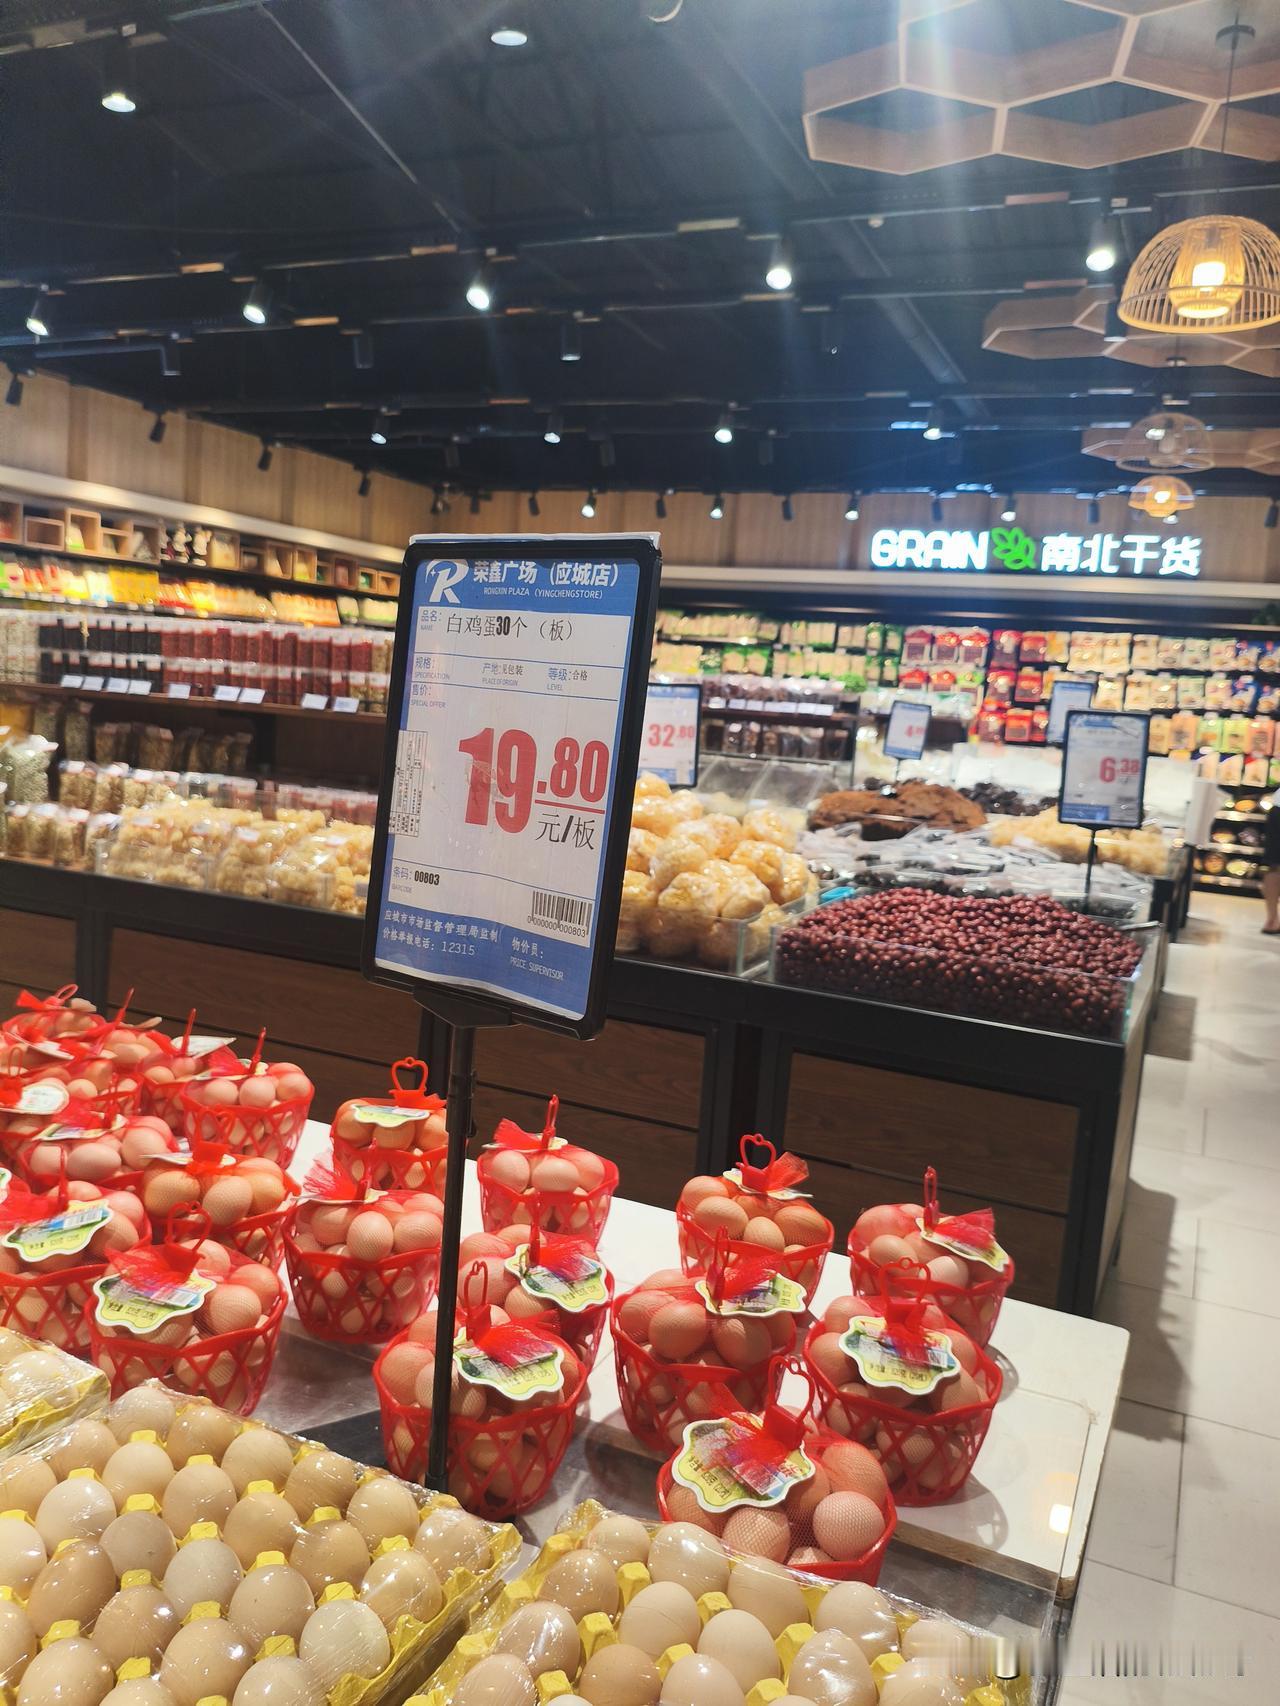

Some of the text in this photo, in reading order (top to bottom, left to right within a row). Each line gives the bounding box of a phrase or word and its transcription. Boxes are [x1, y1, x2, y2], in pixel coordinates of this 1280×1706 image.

[870, 529, 990, 570] GRAIN
[1040, 532, 1203, 577] 南北干货
[508, 587, 530, 597] PLAZA
[459, 728, 609, 833] 19.80
[536, 813, 594, 850] 元/板
[414, 870, 440, 886] 00803
[384, 910, 498, 943] 应城市市场监督管理局监制
[441, 941, 476, 956] 12315
[528, 962, 564, 980] SUPERVISOR
